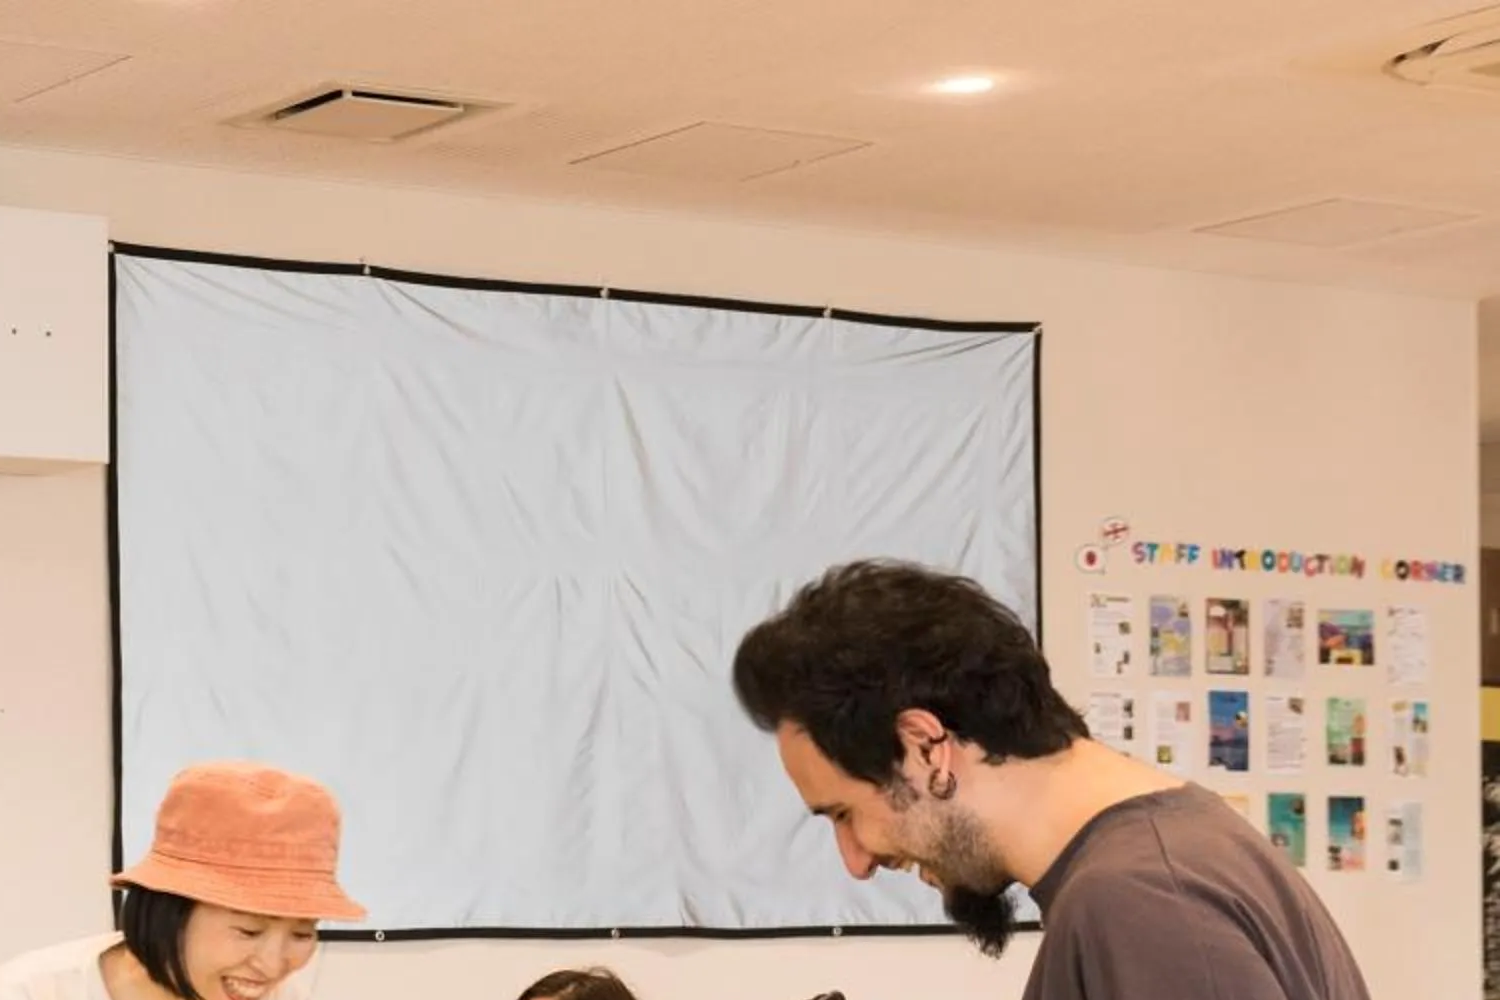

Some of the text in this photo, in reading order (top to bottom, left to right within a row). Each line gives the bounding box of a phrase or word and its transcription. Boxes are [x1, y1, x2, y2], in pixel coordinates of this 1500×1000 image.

[1131, 542, 1466, 585] STAFF INTRODUCTION CORNER
